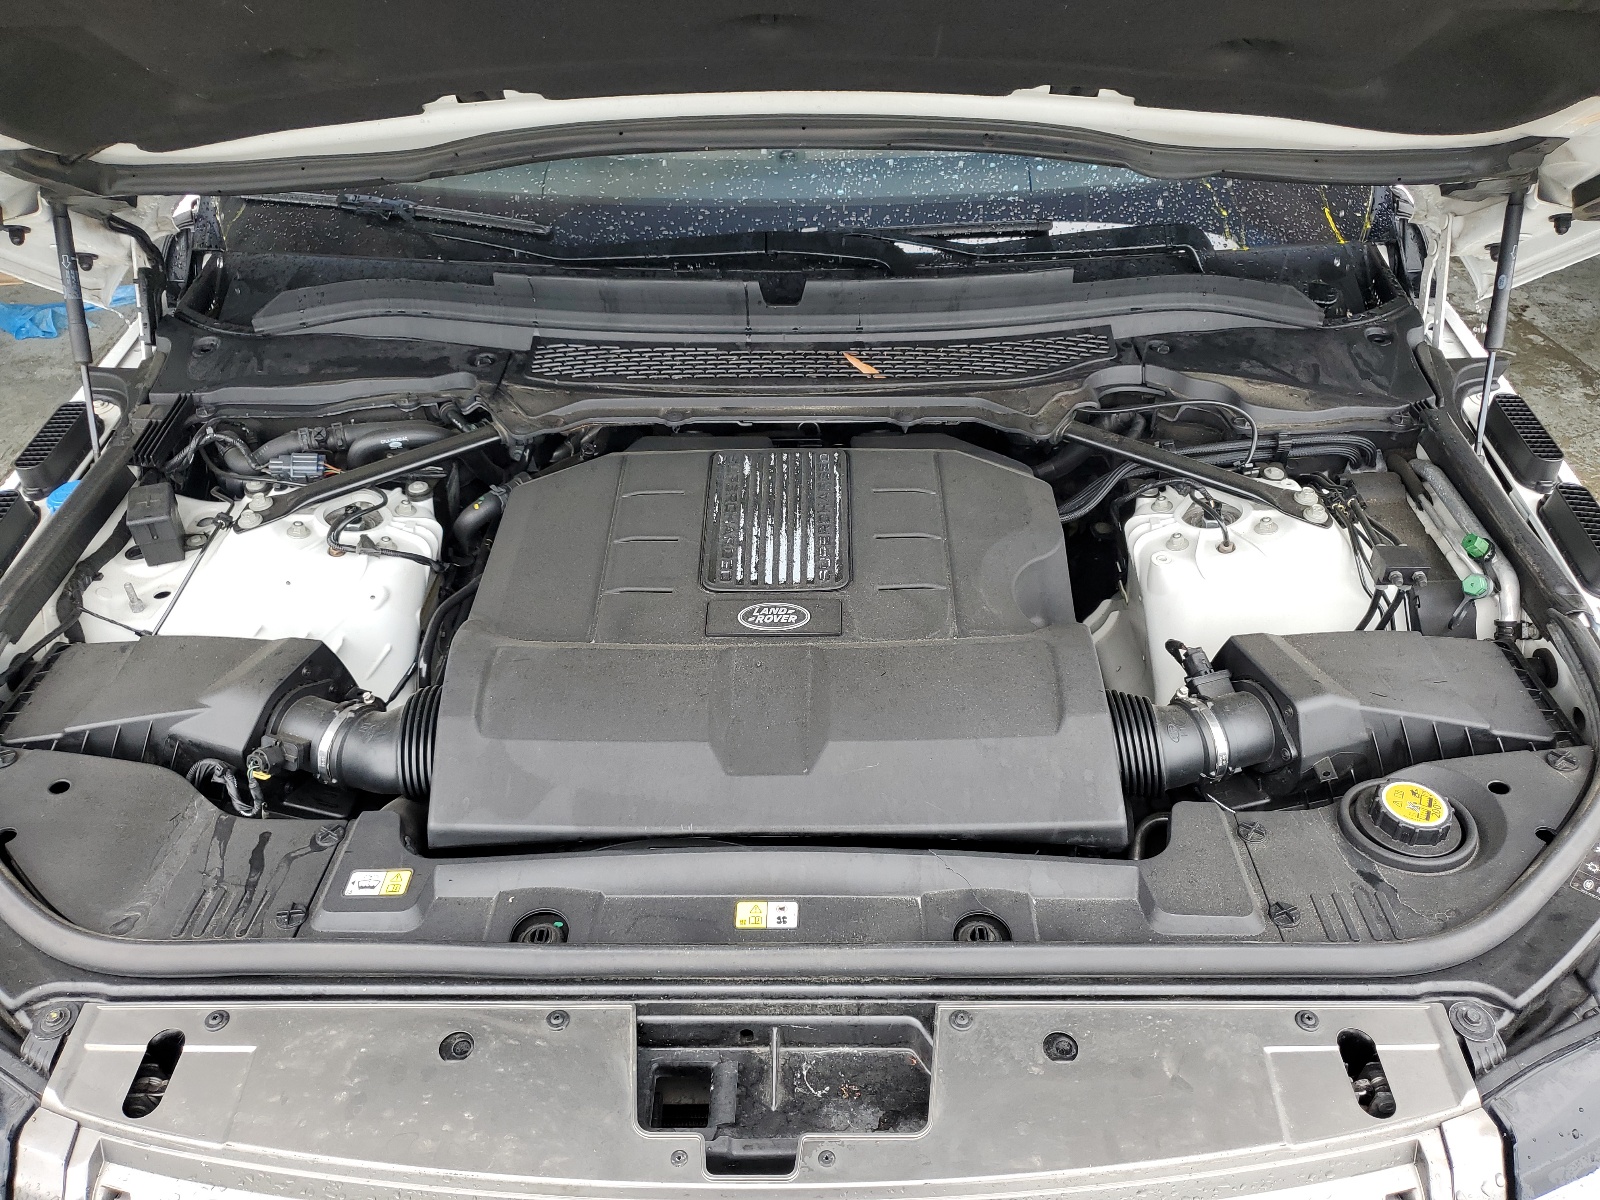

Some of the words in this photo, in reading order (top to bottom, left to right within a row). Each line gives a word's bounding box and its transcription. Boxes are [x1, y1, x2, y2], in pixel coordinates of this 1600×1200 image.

[818, 453, 830, 580] SUPERCHARGED
[752, 607, 788, 616] LAND
[754, 614, 797, 624] ROVER
